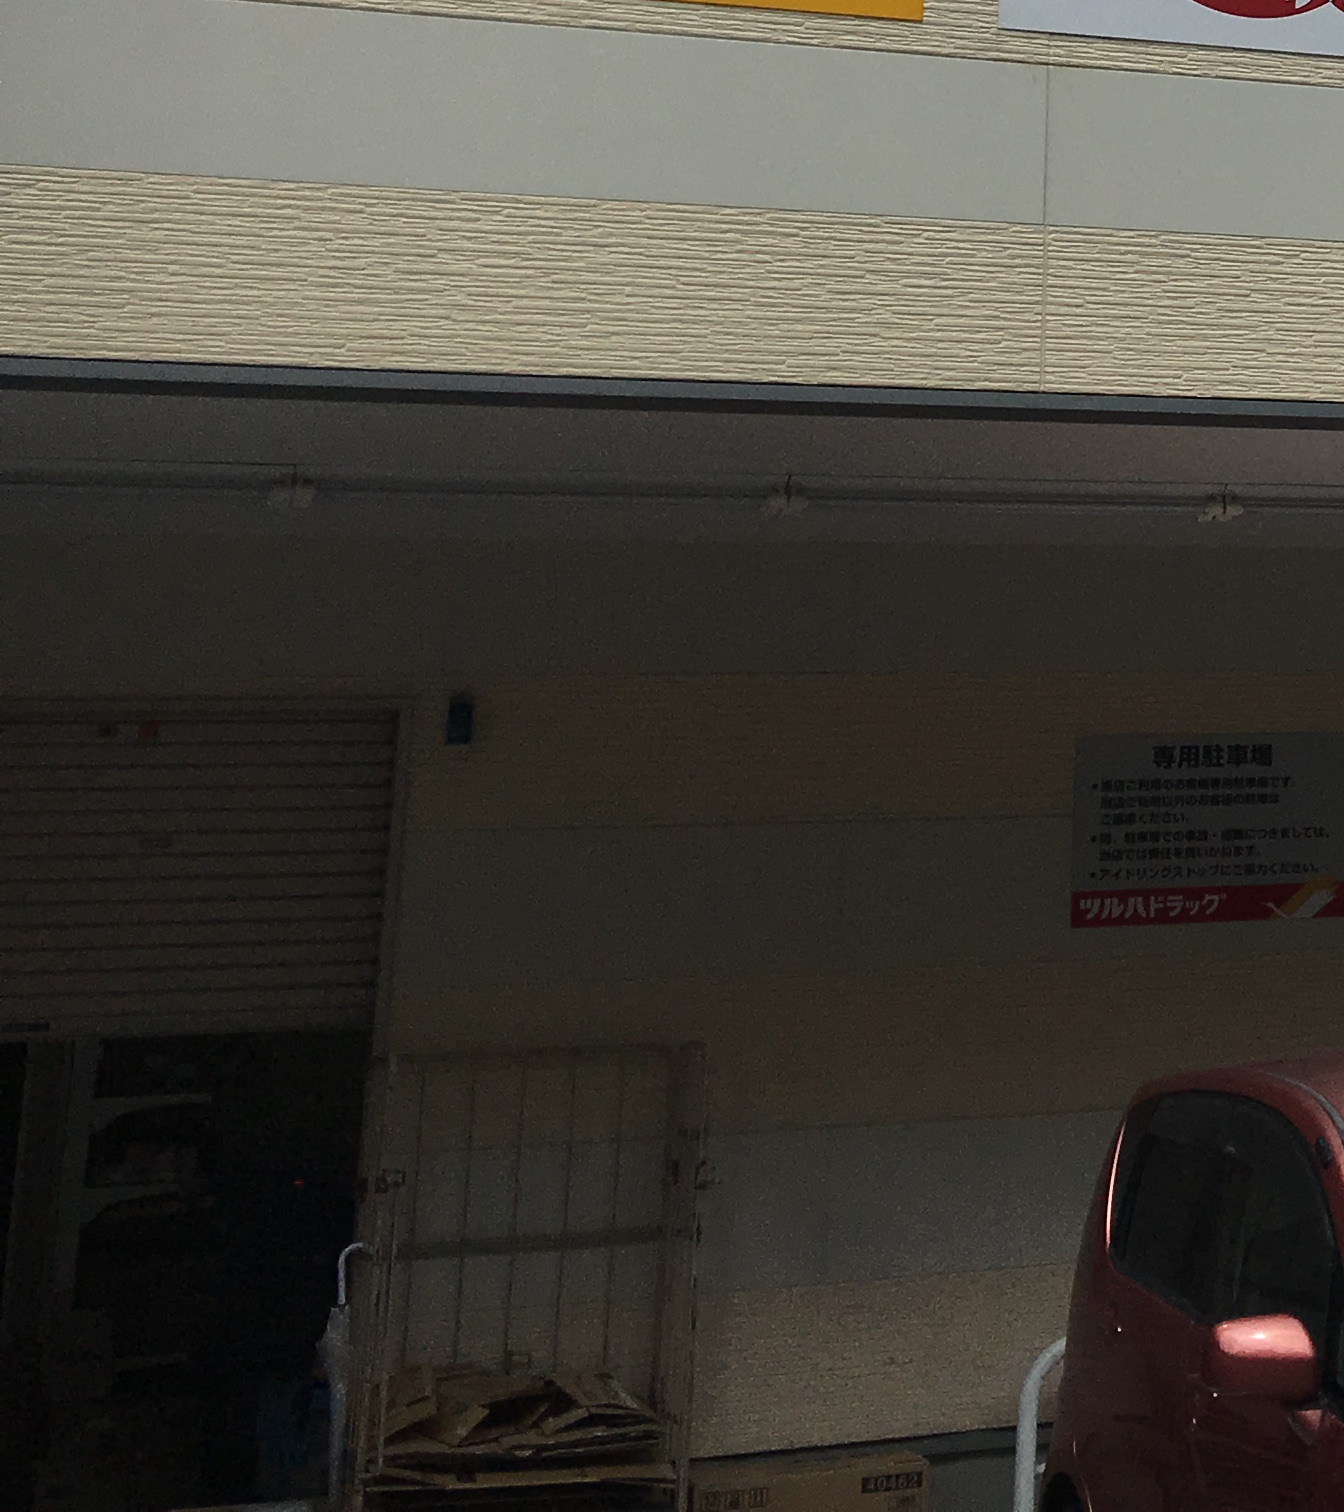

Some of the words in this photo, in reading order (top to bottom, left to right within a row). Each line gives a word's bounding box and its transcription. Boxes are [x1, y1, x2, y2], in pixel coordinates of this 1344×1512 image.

[1152, 743, 1273, 769] 専用駐車場
[1079, 893, 1227, 920] ツルハドラッグ
